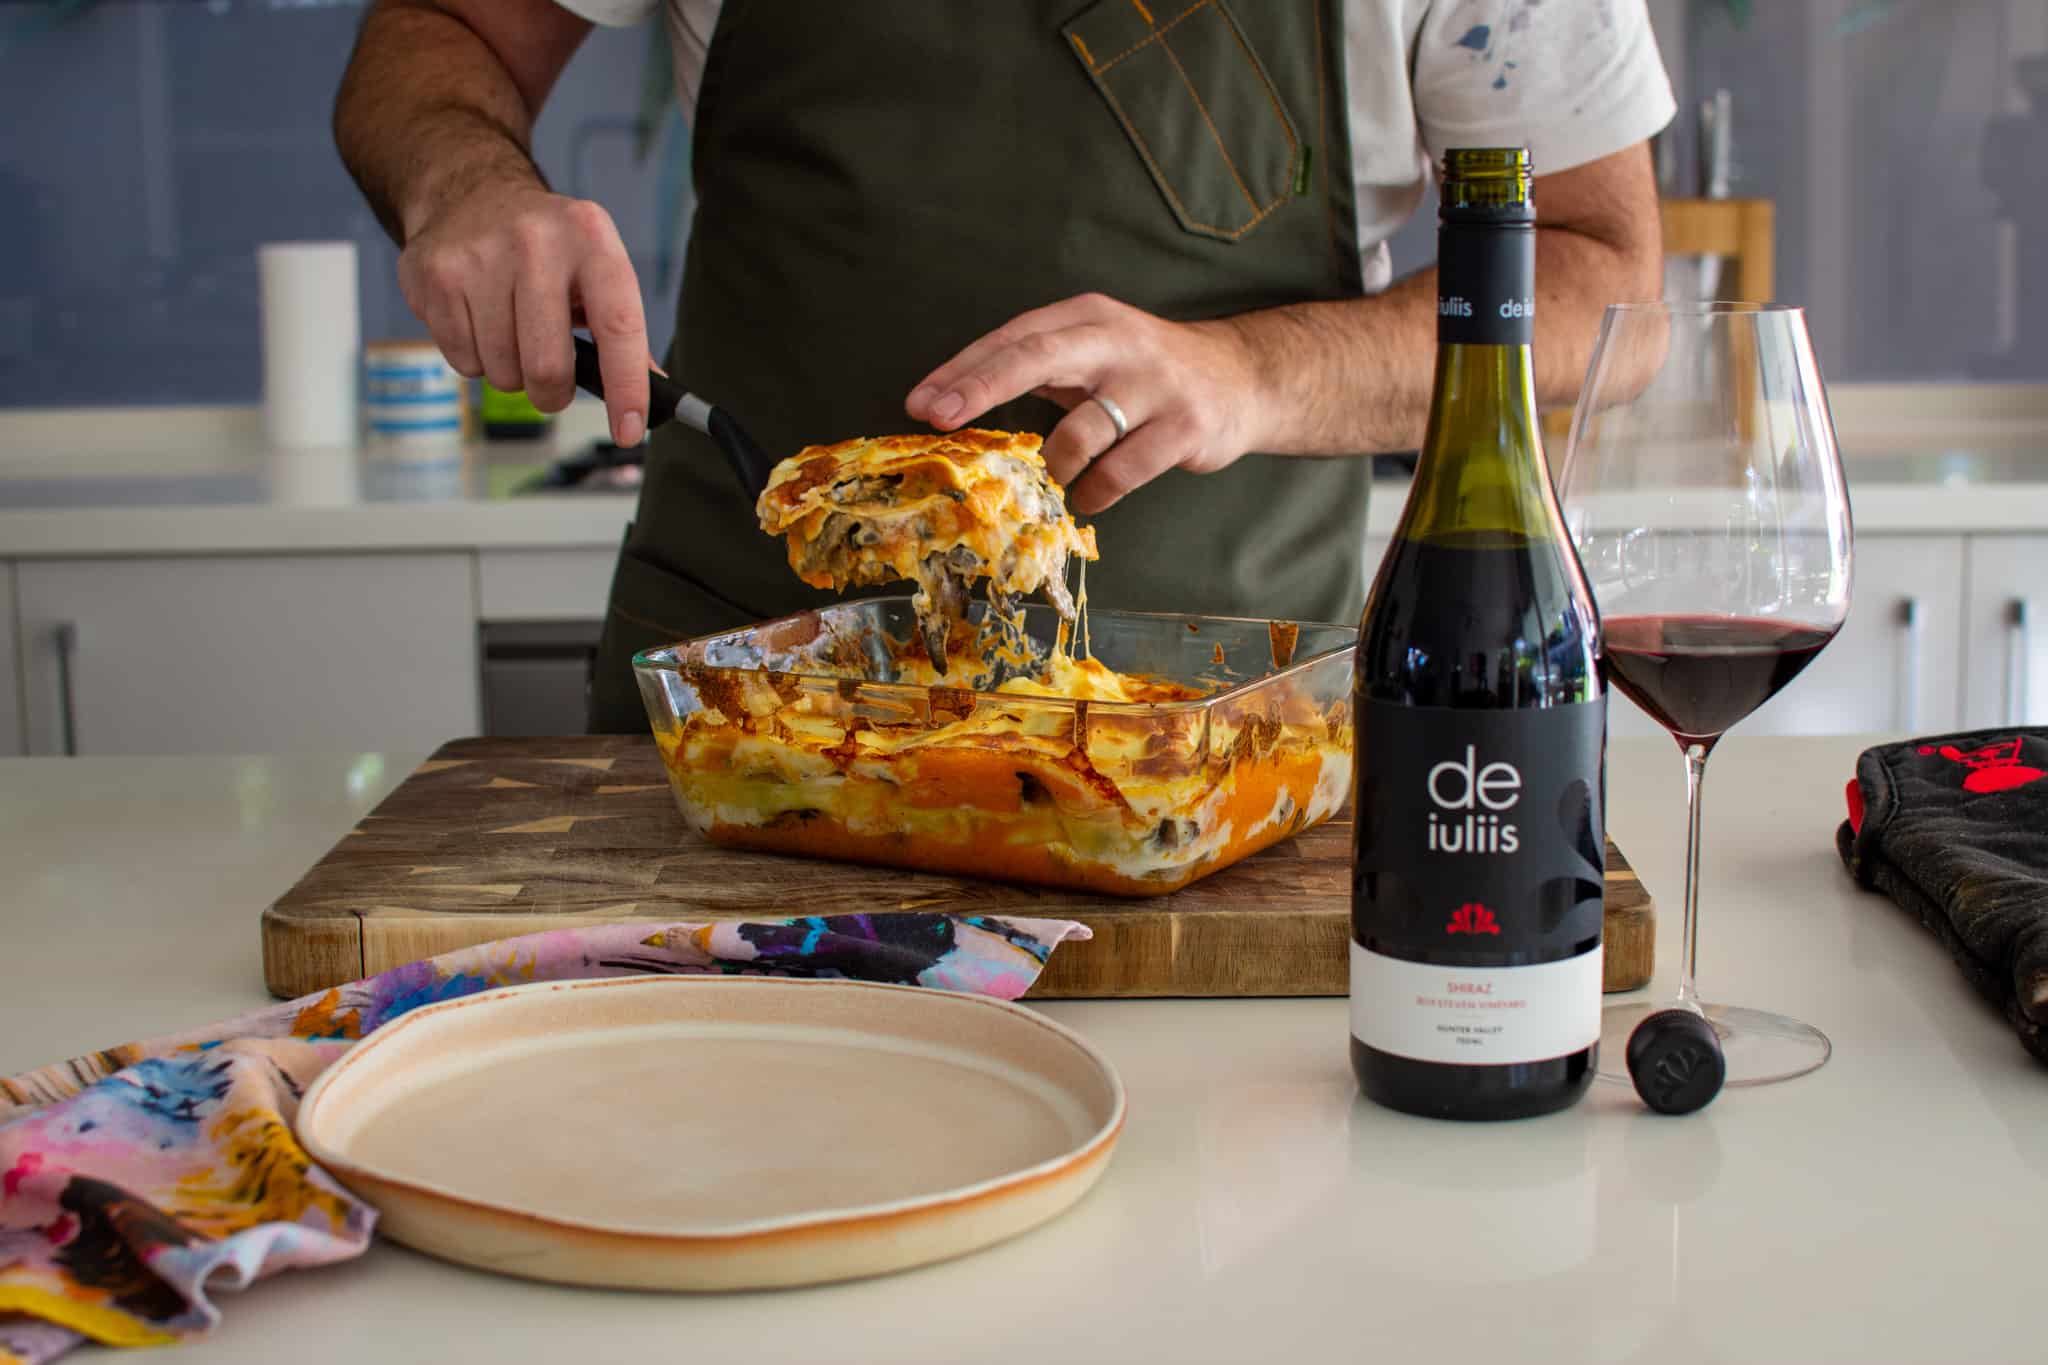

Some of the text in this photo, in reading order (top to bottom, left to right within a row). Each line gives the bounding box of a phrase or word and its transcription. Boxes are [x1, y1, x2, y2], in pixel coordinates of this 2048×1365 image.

[1427, 743, 1522, 811] de
[1428, 812, 1520, 854] iuliis
[1447, 981, 1493, 994] SHIRAZ
